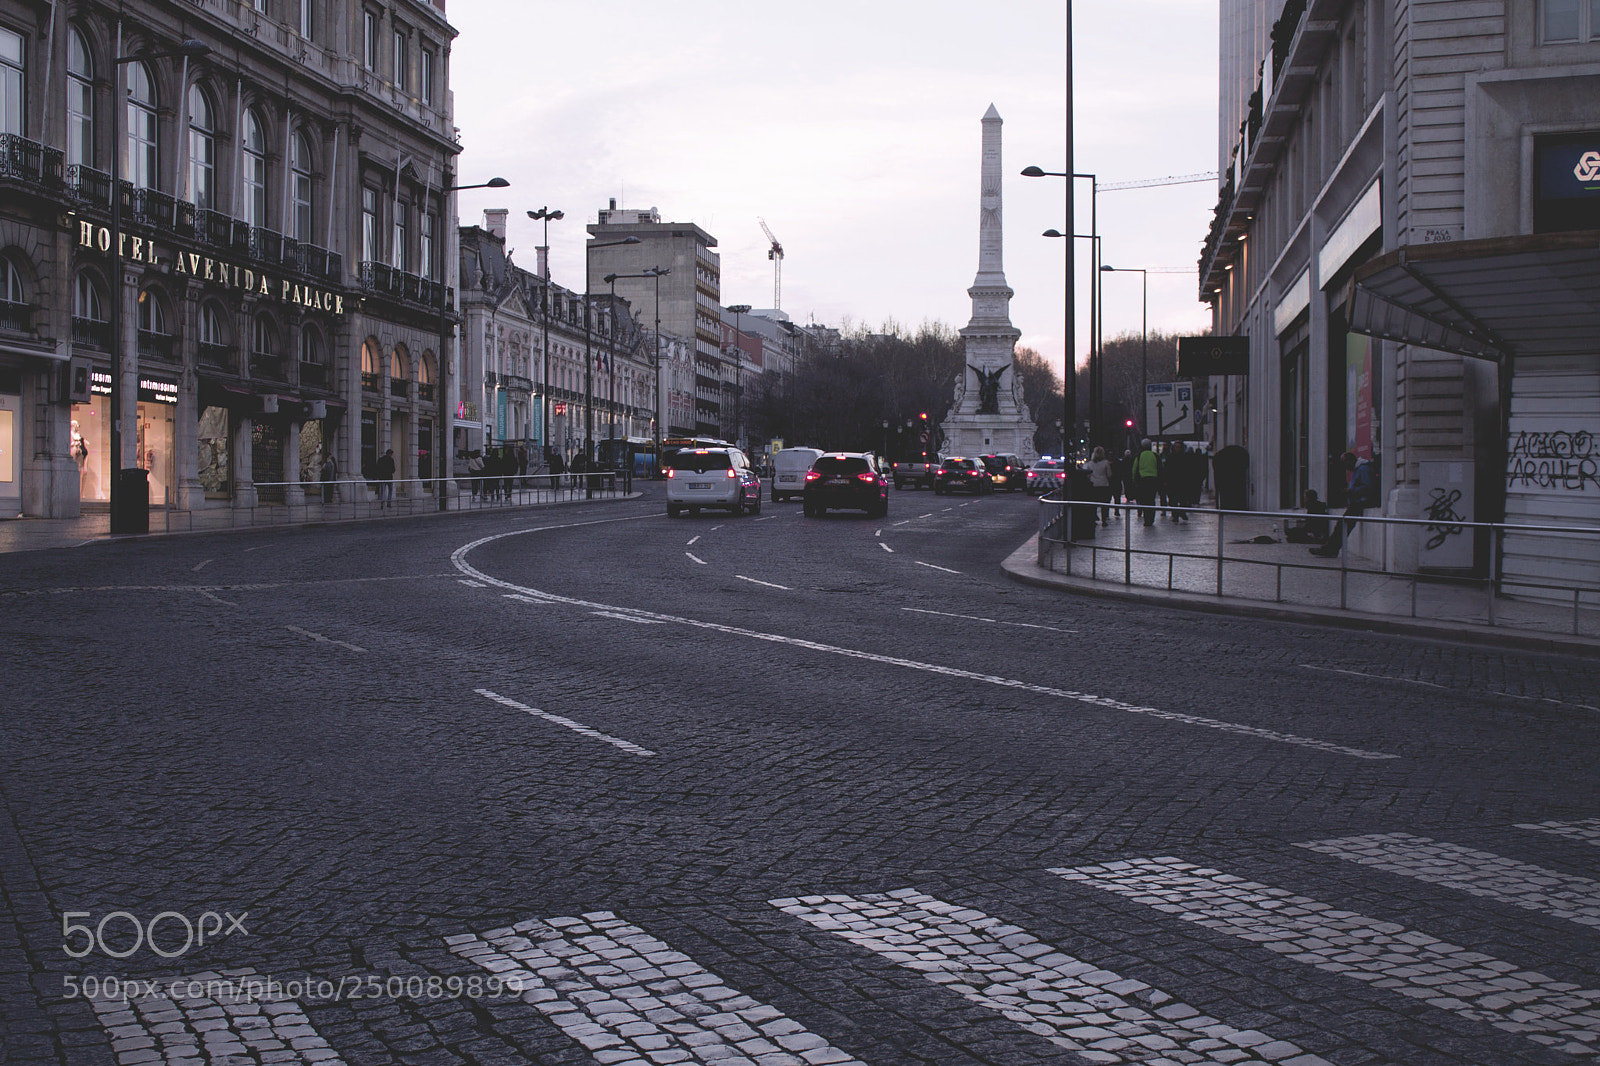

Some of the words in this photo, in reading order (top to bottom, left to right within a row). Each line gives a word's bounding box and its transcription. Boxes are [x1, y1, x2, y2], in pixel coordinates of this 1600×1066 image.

[79, 220, 158, 265] HOTEL
[175, 251, 269, 295] AVENIDA
[281, 279, 344, 315] PALACE
[140, 379, 178, 393] intimissimi
[1181, 391, 1188, 401] P
